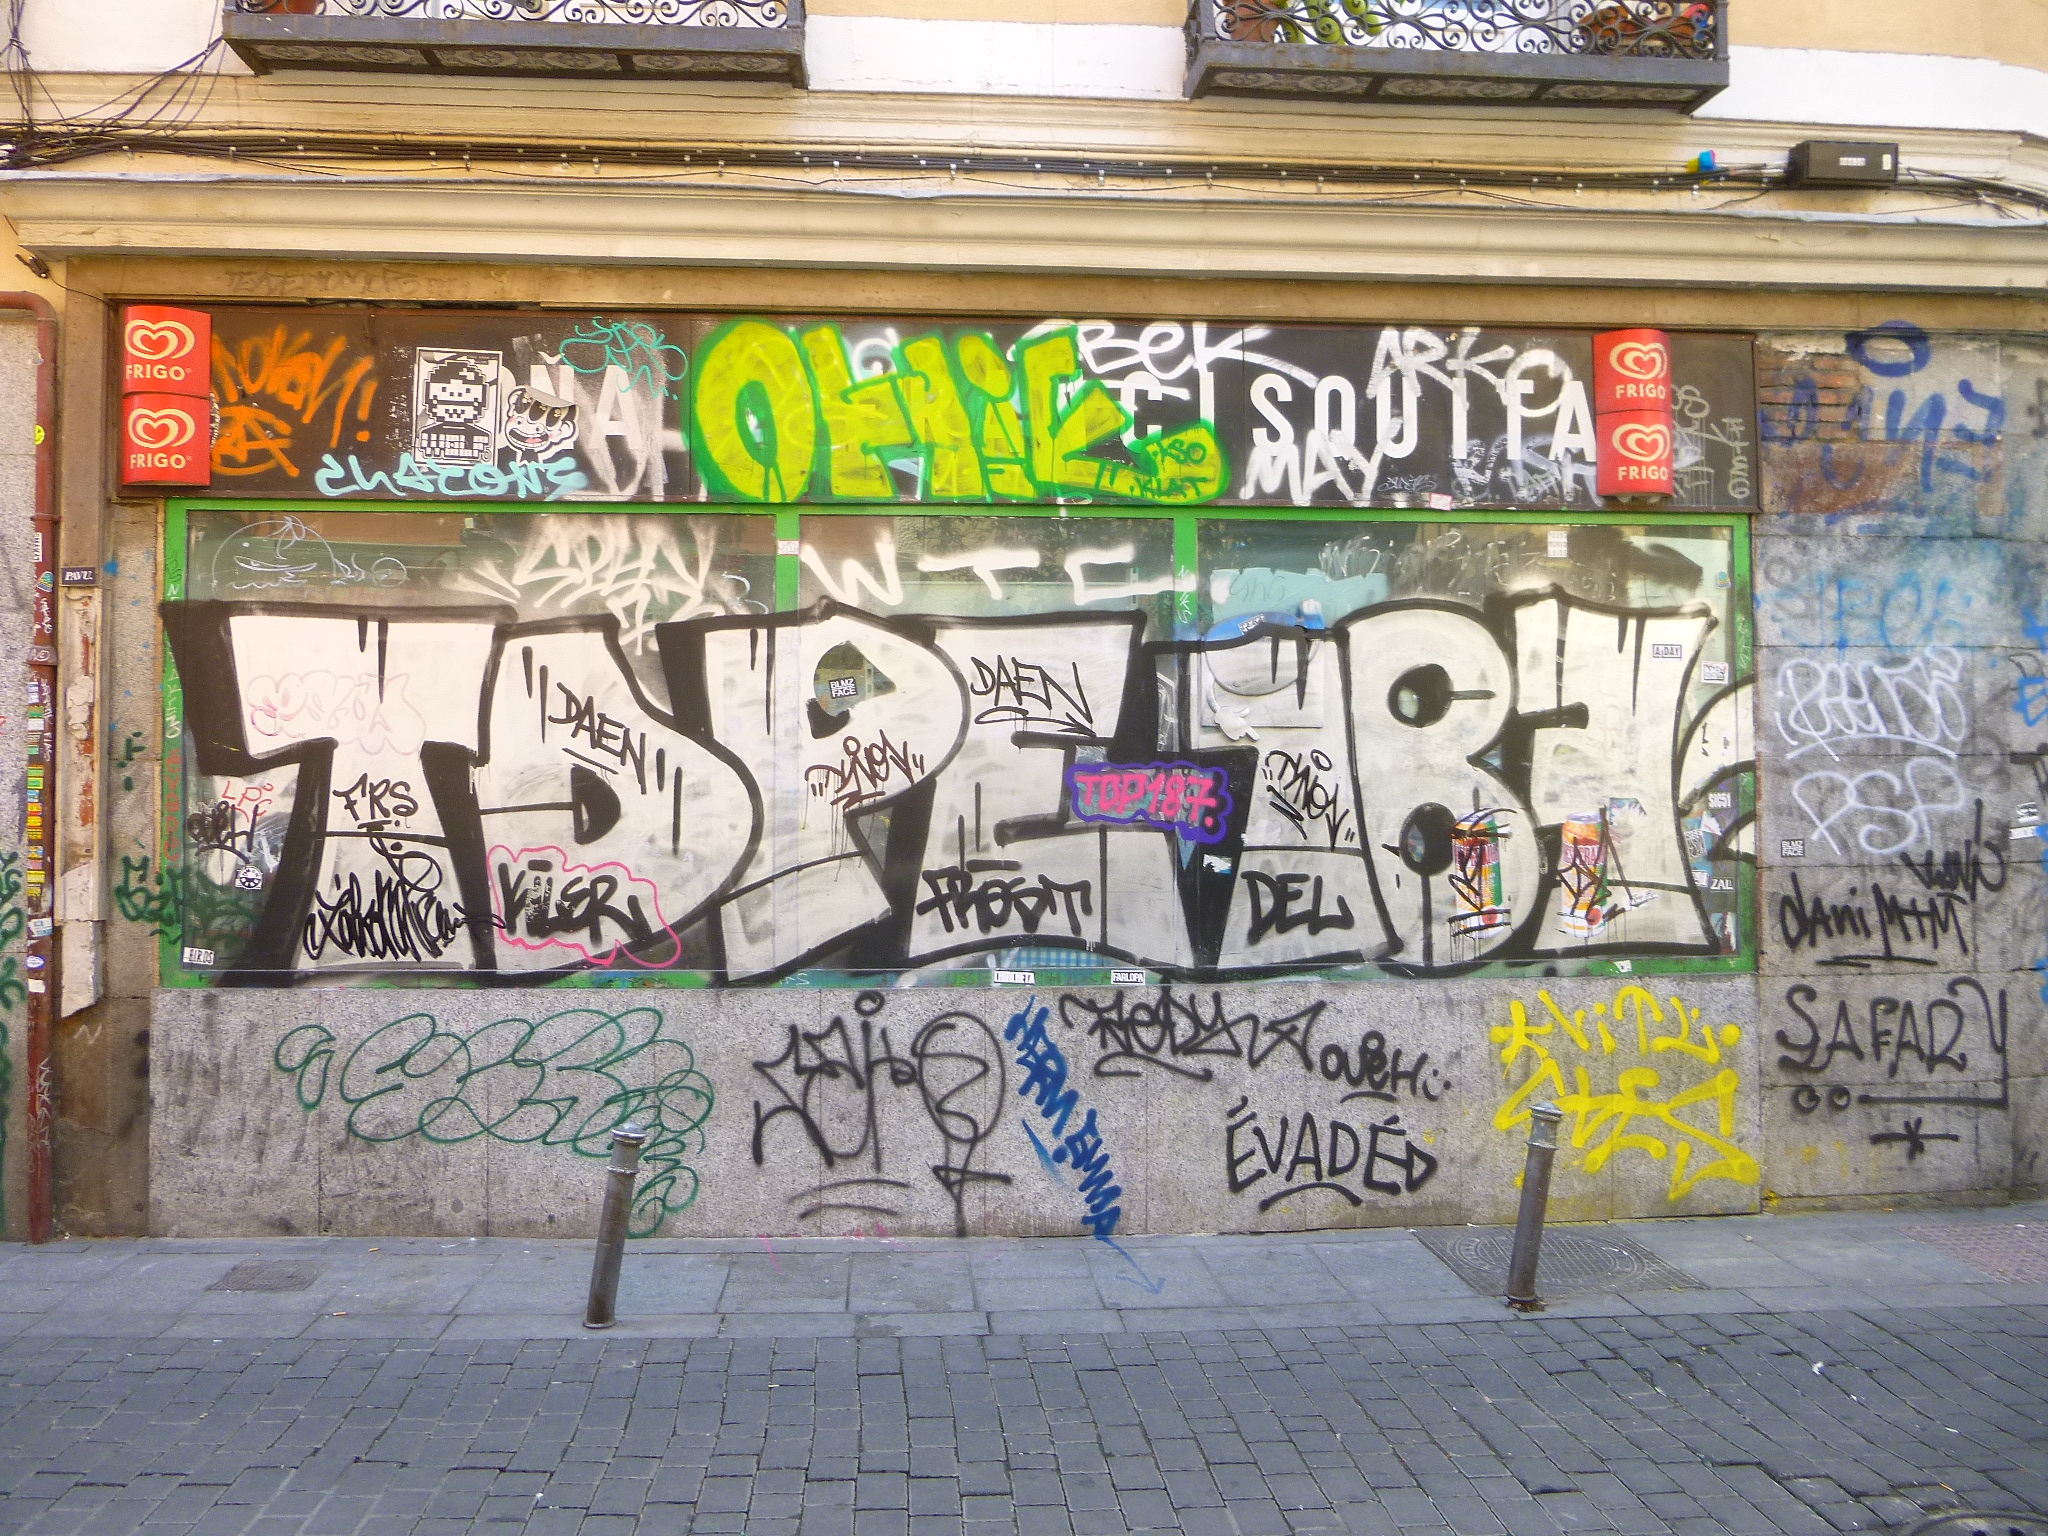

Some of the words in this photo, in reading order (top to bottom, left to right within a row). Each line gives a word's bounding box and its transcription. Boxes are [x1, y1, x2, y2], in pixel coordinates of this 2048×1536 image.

[126, 363, 186, 381] FRIGO
[1615, 384, 1666, 400] FRIGO
[130, 453, 186, 470] FRIGO
[1617, 465, 1668, 482] FRIGO
[1112, 973, 1144, 983] FARLOPA
